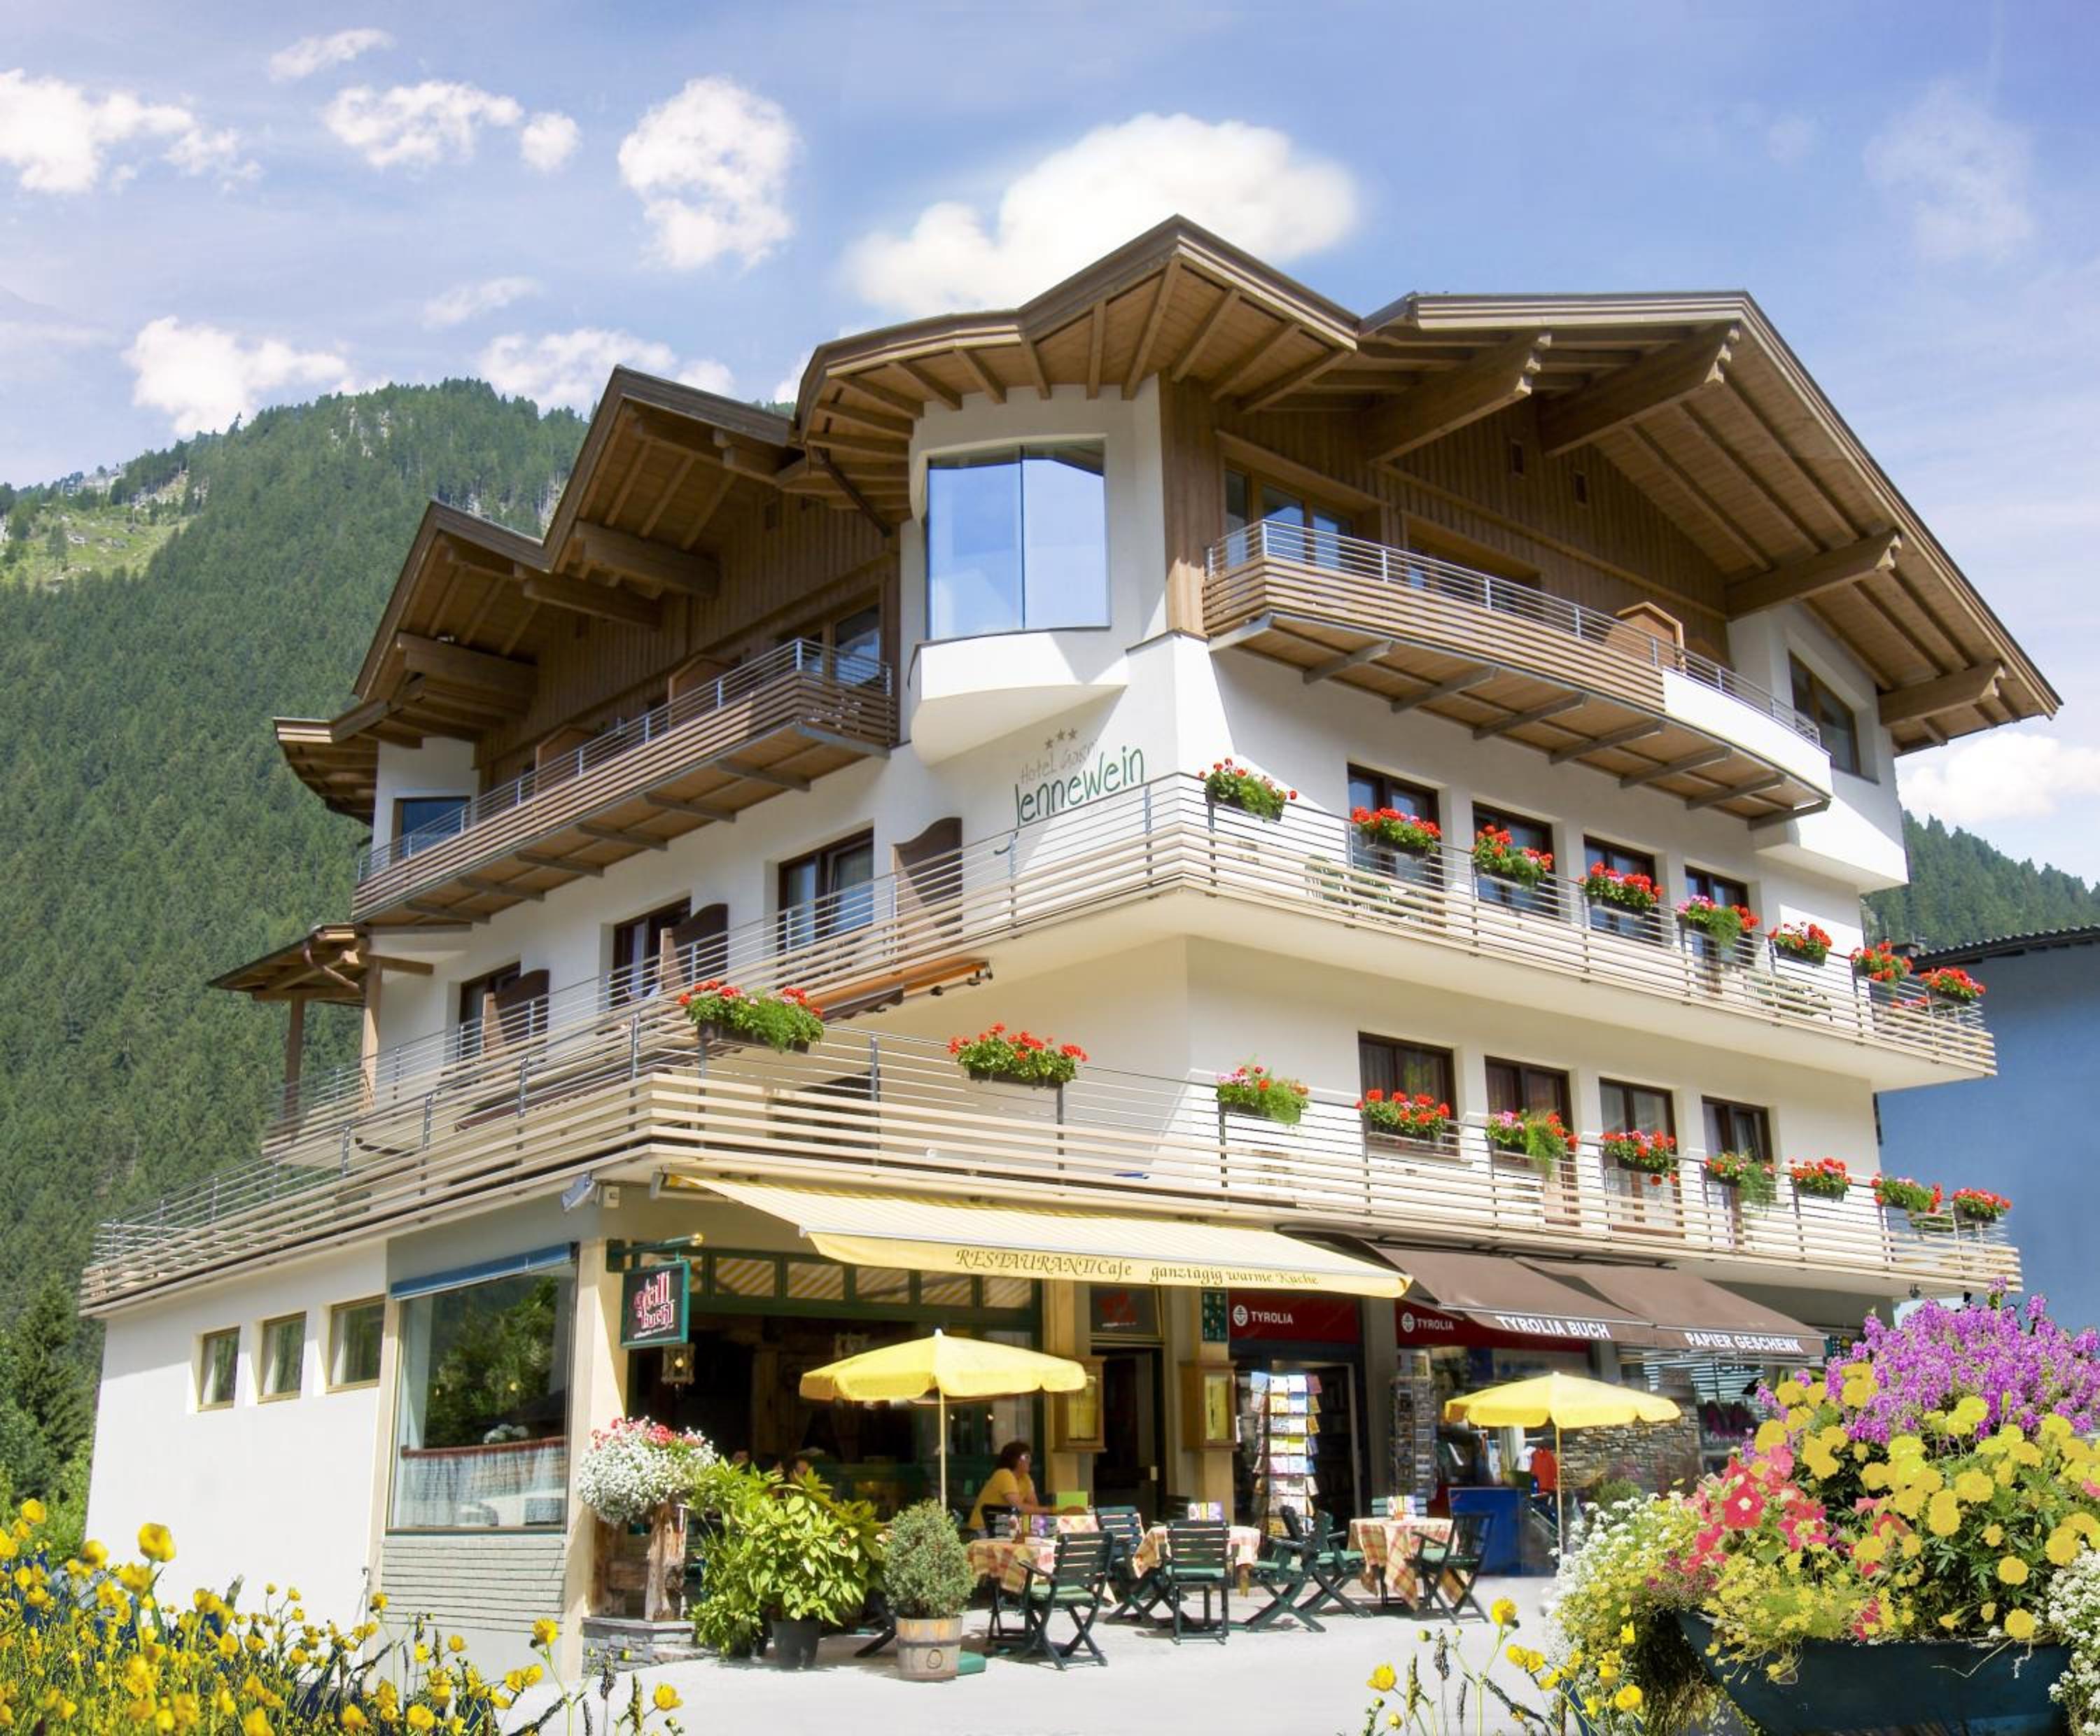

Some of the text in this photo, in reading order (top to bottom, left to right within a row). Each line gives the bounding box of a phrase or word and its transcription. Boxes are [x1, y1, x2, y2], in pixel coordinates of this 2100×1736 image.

[1250, 1310, 1294, 1325] TYROLIA
[1417, 1317, 1455, 1331] TYROLIA
[1495, 1315, 1612, 1339] TYROLIA BUCH
[1684, 1331, 1804, 1354] PAPIER GESCHENK
